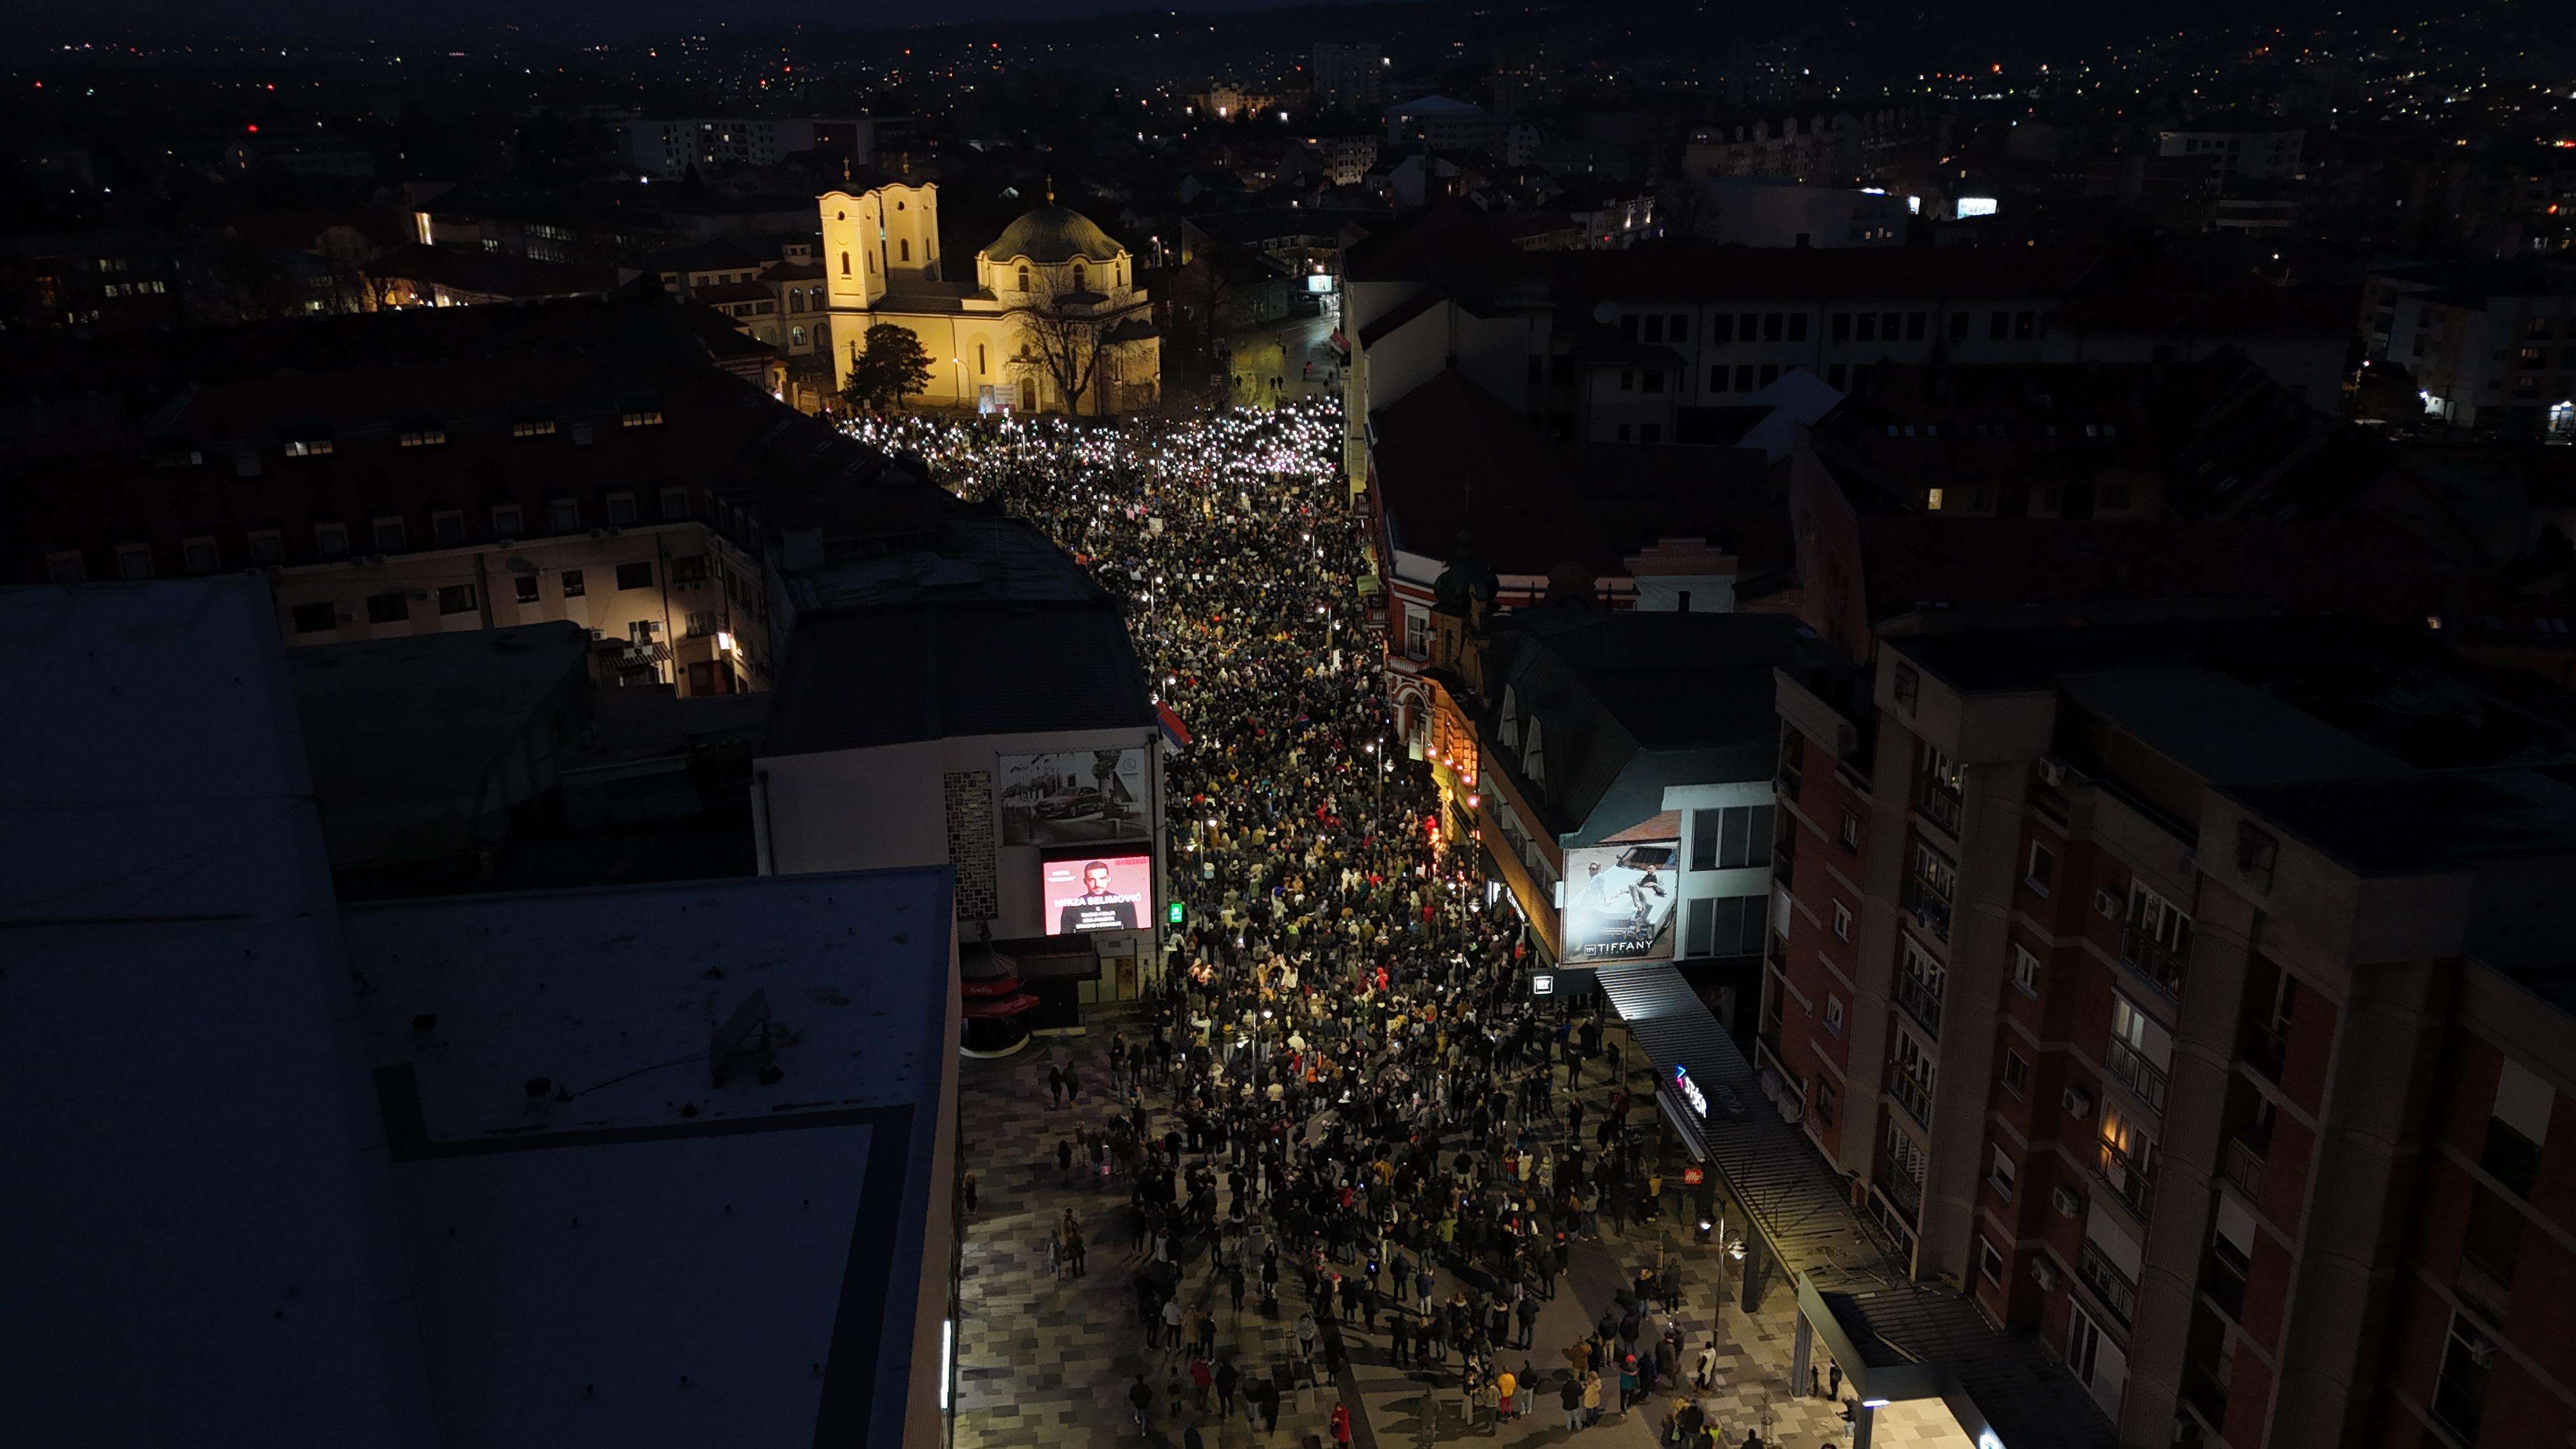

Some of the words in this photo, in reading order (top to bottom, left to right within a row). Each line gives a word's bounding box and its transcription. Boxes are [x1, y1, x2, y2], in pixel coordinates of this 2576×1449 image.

[1055, 896, 1087, 908] MIRZA
[1597, 940, 1653, 952] TIFFANY
[1685, 1171, 1700, 1181] illy
